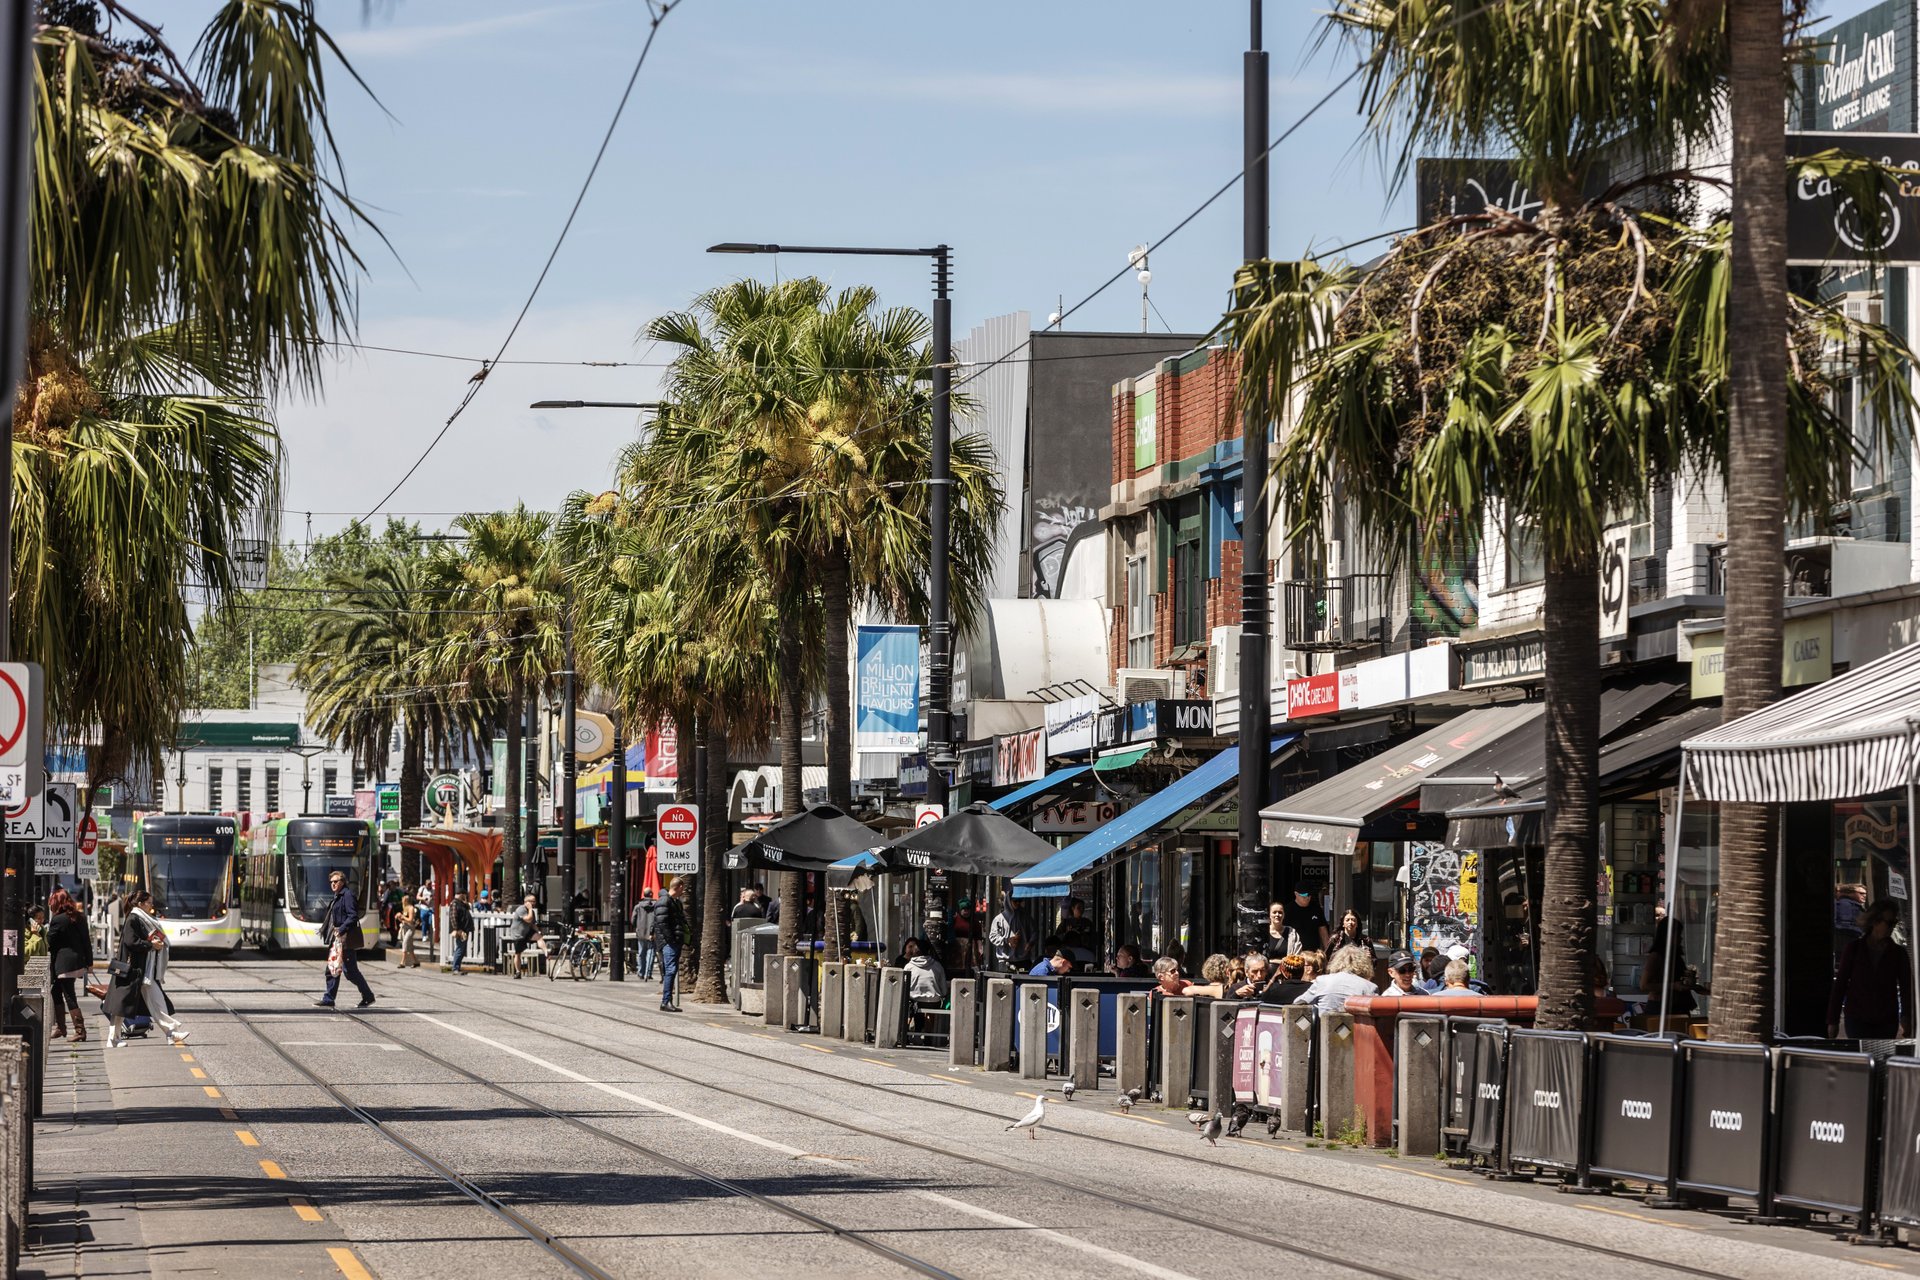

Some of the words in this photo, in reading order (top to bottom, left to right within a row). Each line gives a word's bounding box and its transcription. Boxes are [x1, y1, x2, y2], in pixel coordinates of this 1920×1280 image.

[1819, 33, 1868, 105] Acland
[1833, 99, 1860, 130] COFFEE
[1862, 84, 1891, 118] LOUNGE
[871, 650, 882, 662] A
[1793, 637, 1820, 662] CAKES
[1472, 652, 1486, 680] THE
[1487, 646, 1518, 678] ACLAND
[1519, 642, 1541, 673] CAKE
[1310, 687, 1322, 705] CARE
[1321, 685, 1335, 704] CLINIC
[861, 695, 915, 713] FLAVOURS
[1175, 704, 1212, 729] MON
[438, 791, 457, 801] VB
[672, 813, 684, 822] NO
[1218, 815, 1238, 825] Grill
[216, 827, 234, 835] 6100
[664, 831, 692, 840] ENTRY
[41, 847, 66, 856] TRAMS
[665, 851, 690, 860] TRAMS
[763, 847, 783, 863] VIVO
[35, 859, 72, 867] EXCEPTED
[81, 858, 95, 866] TRAMS
[906, 853, 931, 866] VIVO
[79, 867, 97, 876] EXCEPTED
[659, 862, 697, 871] EXCEPTED
[1533, 1089, 1560, 1109] rococo
[1621, 1099, 1653, 1120] rococo
[1709, 1109, 1743, 1131] rococo
[1809, 1120, 1845, 1144] rococo
